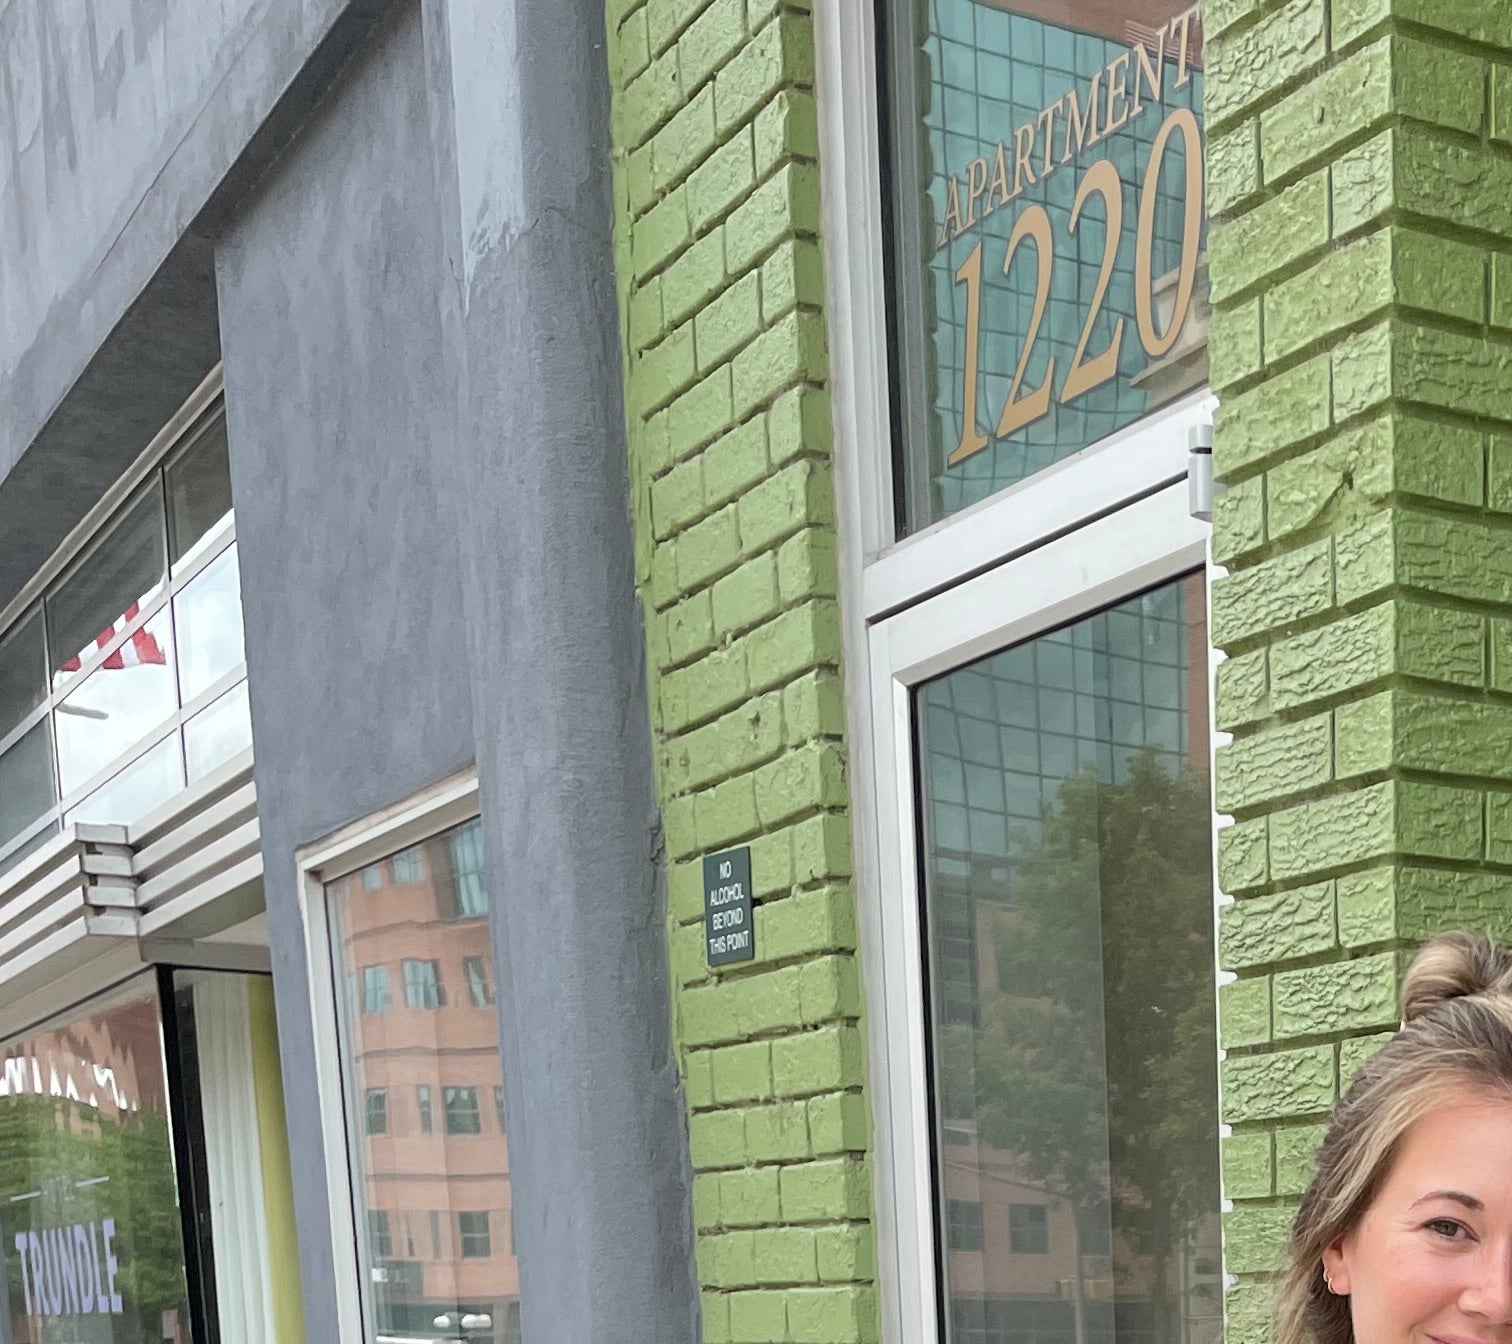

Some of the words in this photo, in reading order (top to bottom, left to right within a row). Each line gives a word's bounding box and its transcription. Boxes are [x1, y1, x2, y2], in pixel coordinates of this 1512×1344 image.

[946, 107, 1203, 469] 1220
[719, 860, 732, 880] NO
[709, 883, 745, 907] ALCOHOL
[712, 907, 744, 931] BEYOND
[709, 935, 726, 955] THIS
[727, 930, 749, 952] POINT
[15, 1218, 123, 1316] TRUNDLE
